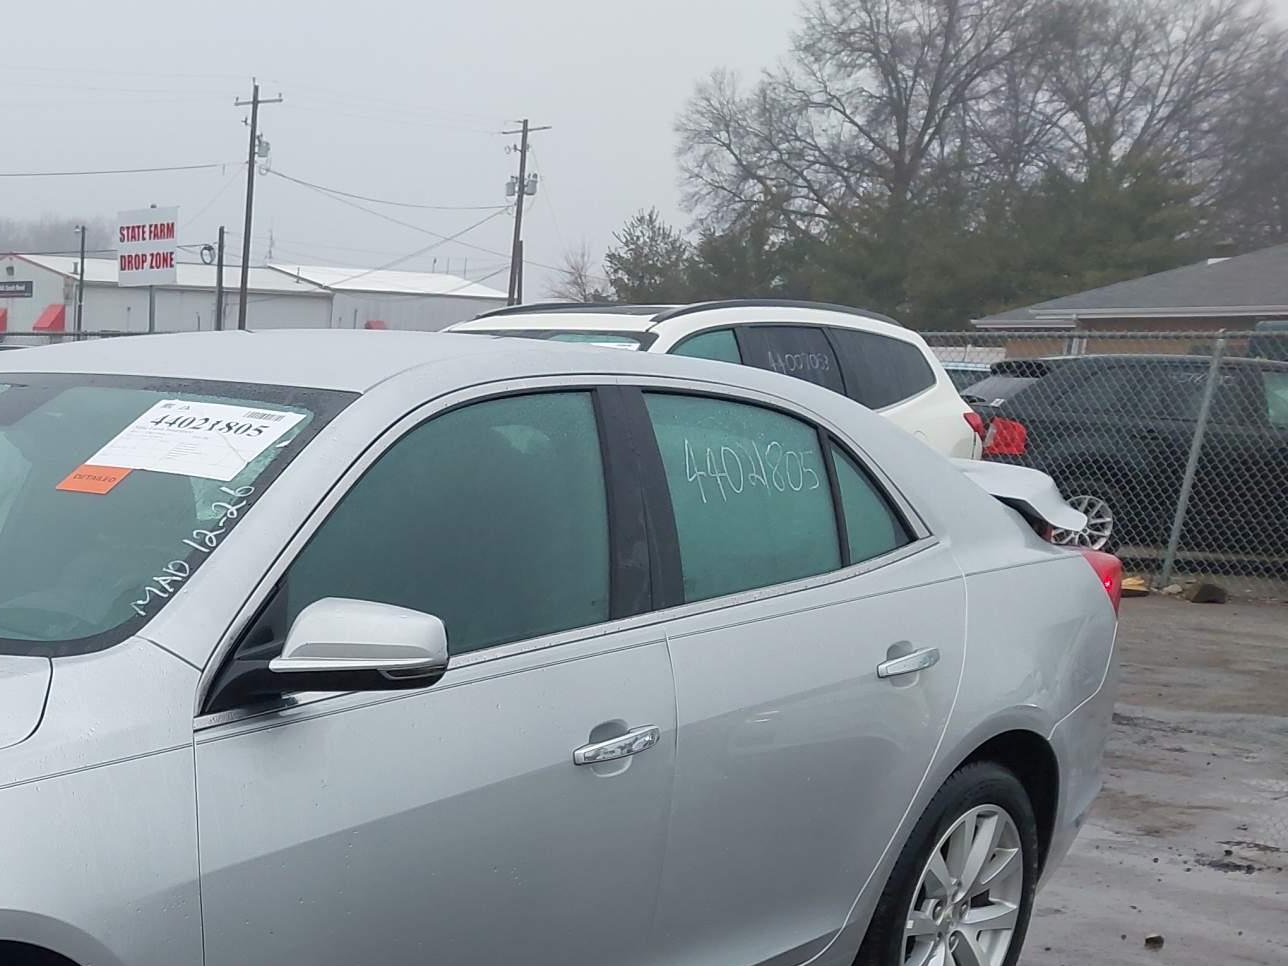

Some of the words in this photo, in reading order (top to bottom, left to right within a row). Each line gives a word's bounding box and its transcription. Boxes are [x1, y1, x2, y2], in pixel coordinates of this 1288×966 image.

[119, 224, 147, 243] STATE
[148, 222, 175, 241] FARM
[119, 253, 147, 272] DROP
[149, 251, 175, 270] ZONE
[151, 409, 269, 437] 44021805
[129, 560, 190, 616] MAD
[181, 485, 256, 553] 12-26
